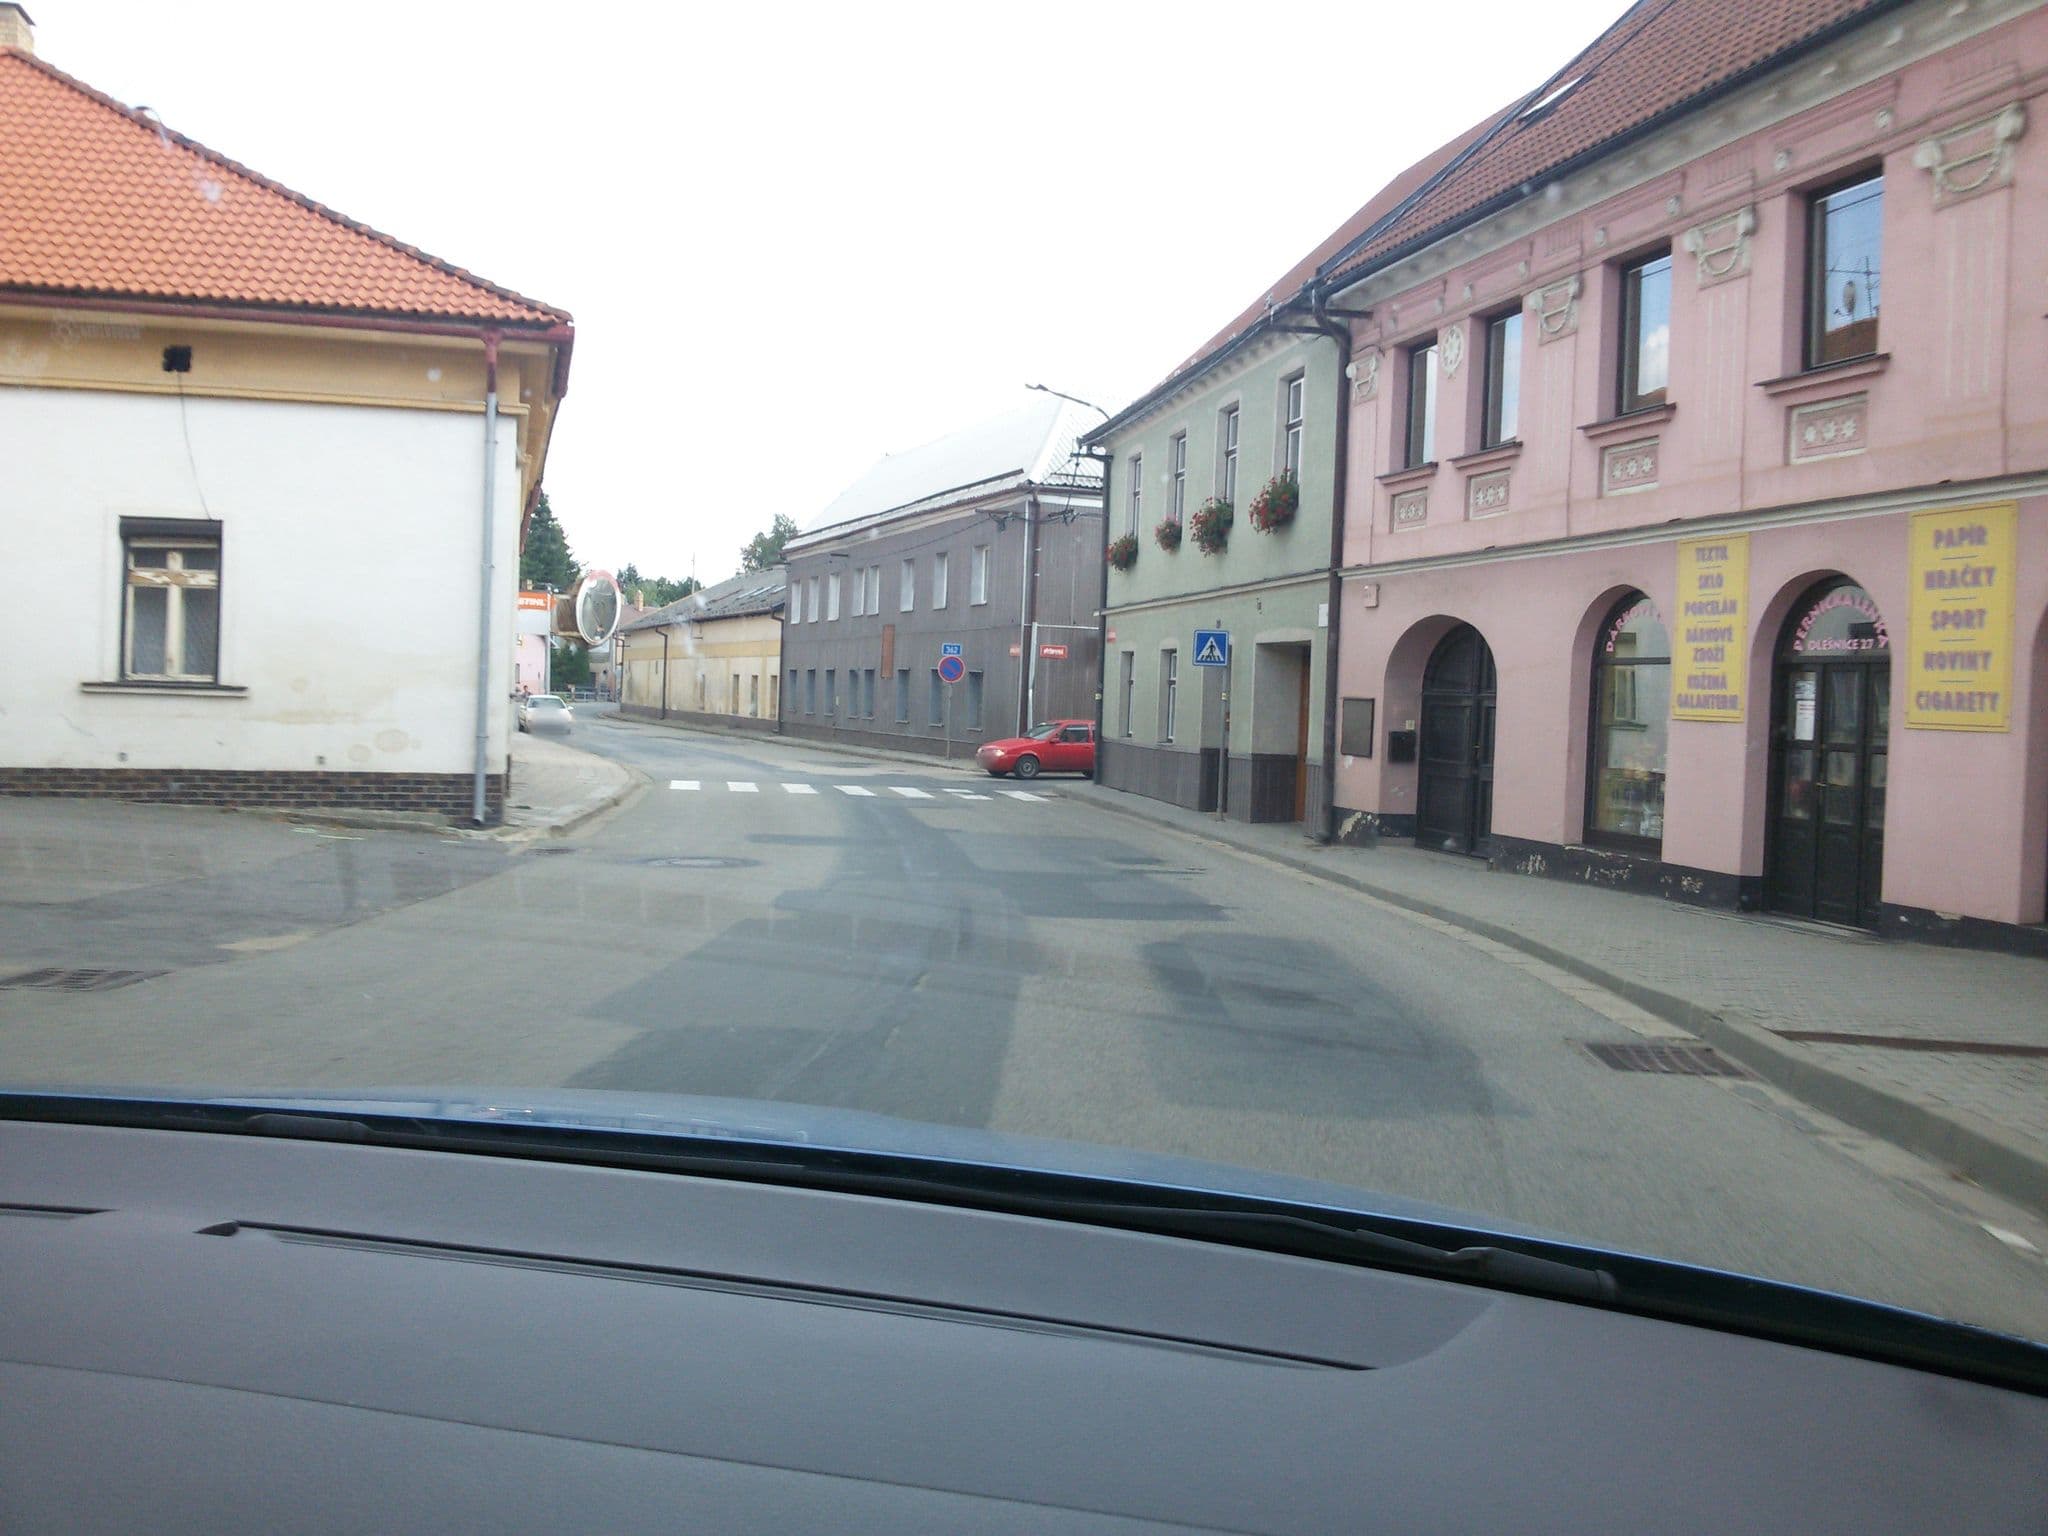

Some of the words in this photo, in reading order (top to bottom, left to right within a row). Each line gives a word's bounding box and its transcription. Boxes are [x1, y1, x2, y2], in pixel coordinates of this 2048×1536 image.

[1933, 524, 1987, 549] PAPÍR
[1698, 574, 1724, 590] SKLO
[1924, 564, 1996, 590] HRAČKY
[1931, 608, 1986, 631] SPORT
[945, 645, 959, 654] 362
[1807, 637, 1859, 651] OLEŠNICE
[1924, 650, 1992, 672] NOVINY
[1916, 691, 1999, 713] CIGARETY
